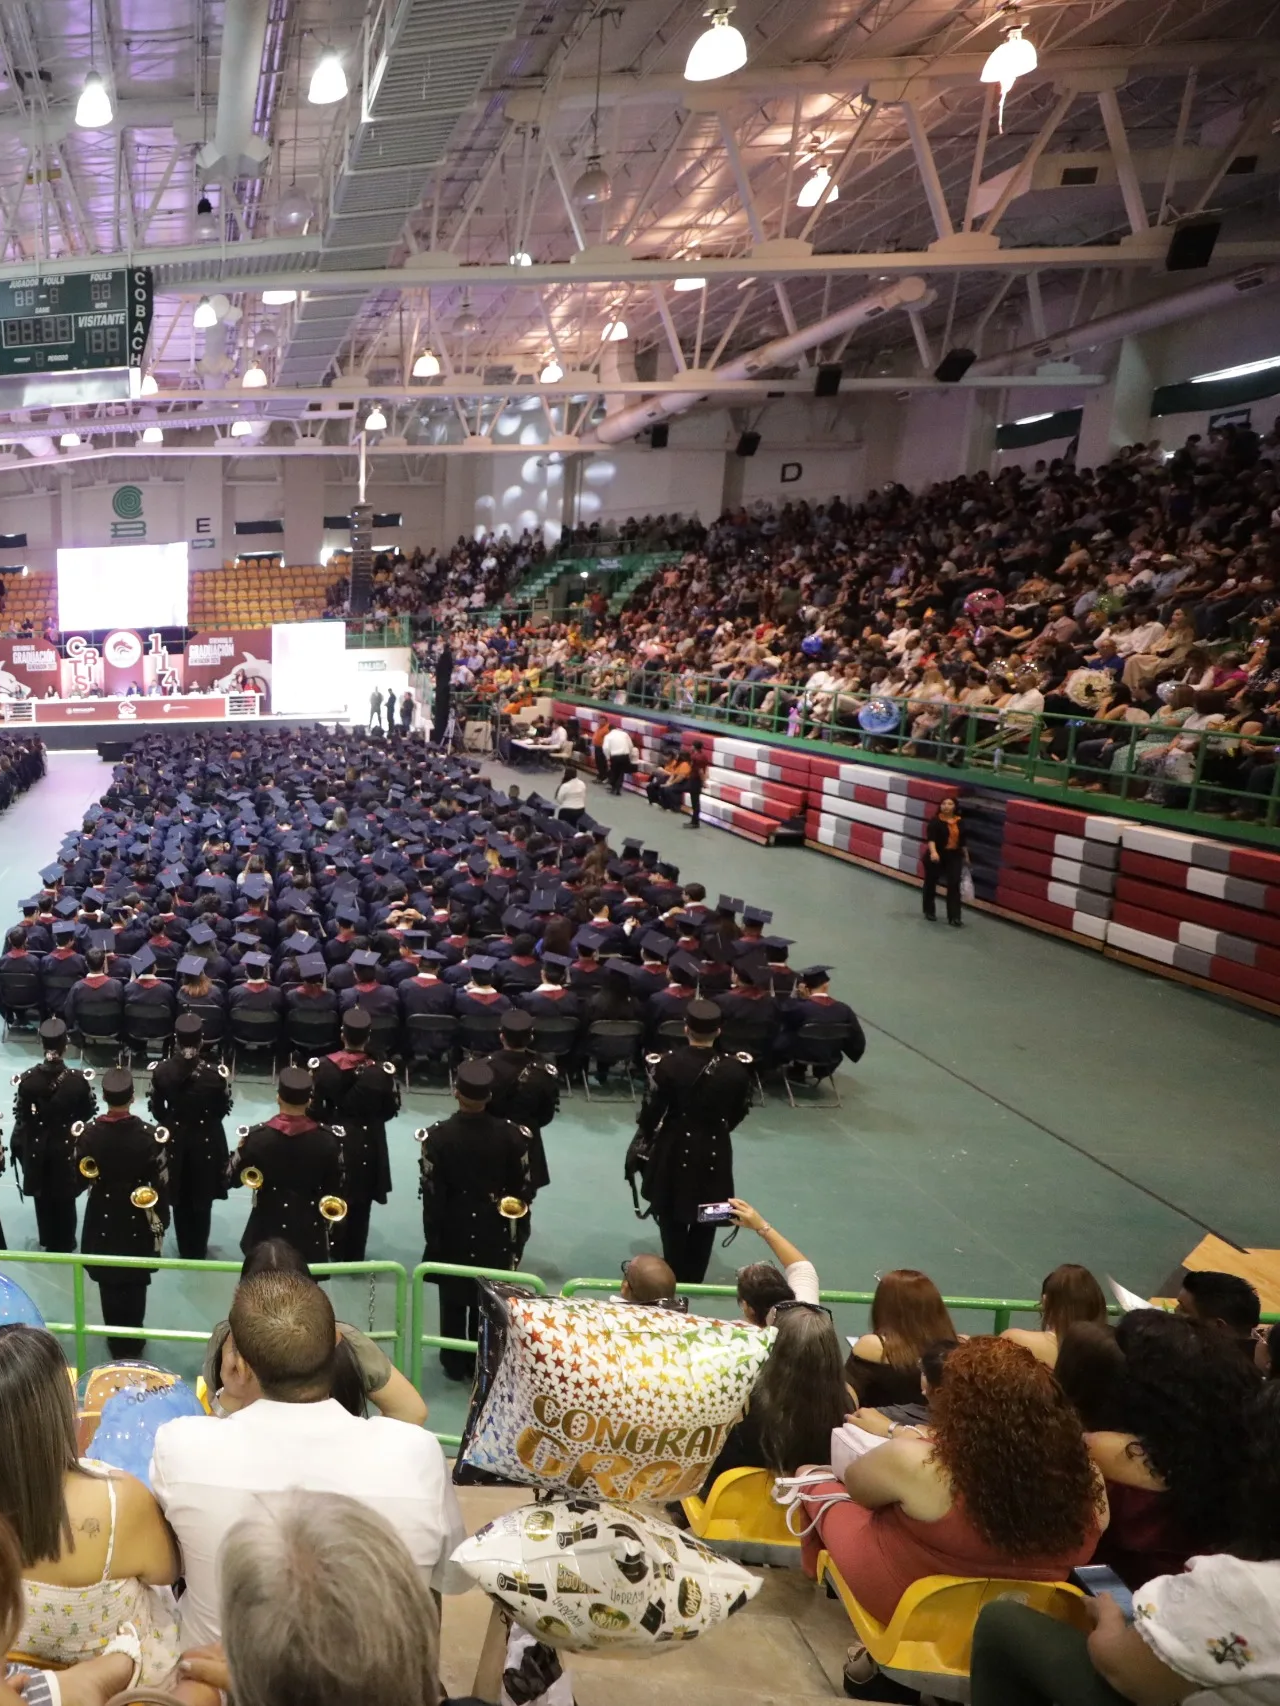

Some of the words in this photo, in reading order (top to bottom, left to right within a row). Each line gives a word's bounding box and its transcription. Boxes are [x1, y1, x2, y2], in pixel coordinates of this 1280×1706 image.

[42, 275, 65, 286] FOULS
[90, 272, 113, 282] FOULS
[78, 313, 126, 328] VISITANTE
[130, 271, 147, 366] COBACH
[780, 462, 803, 483] D
[196, 517, 211, 533] E
